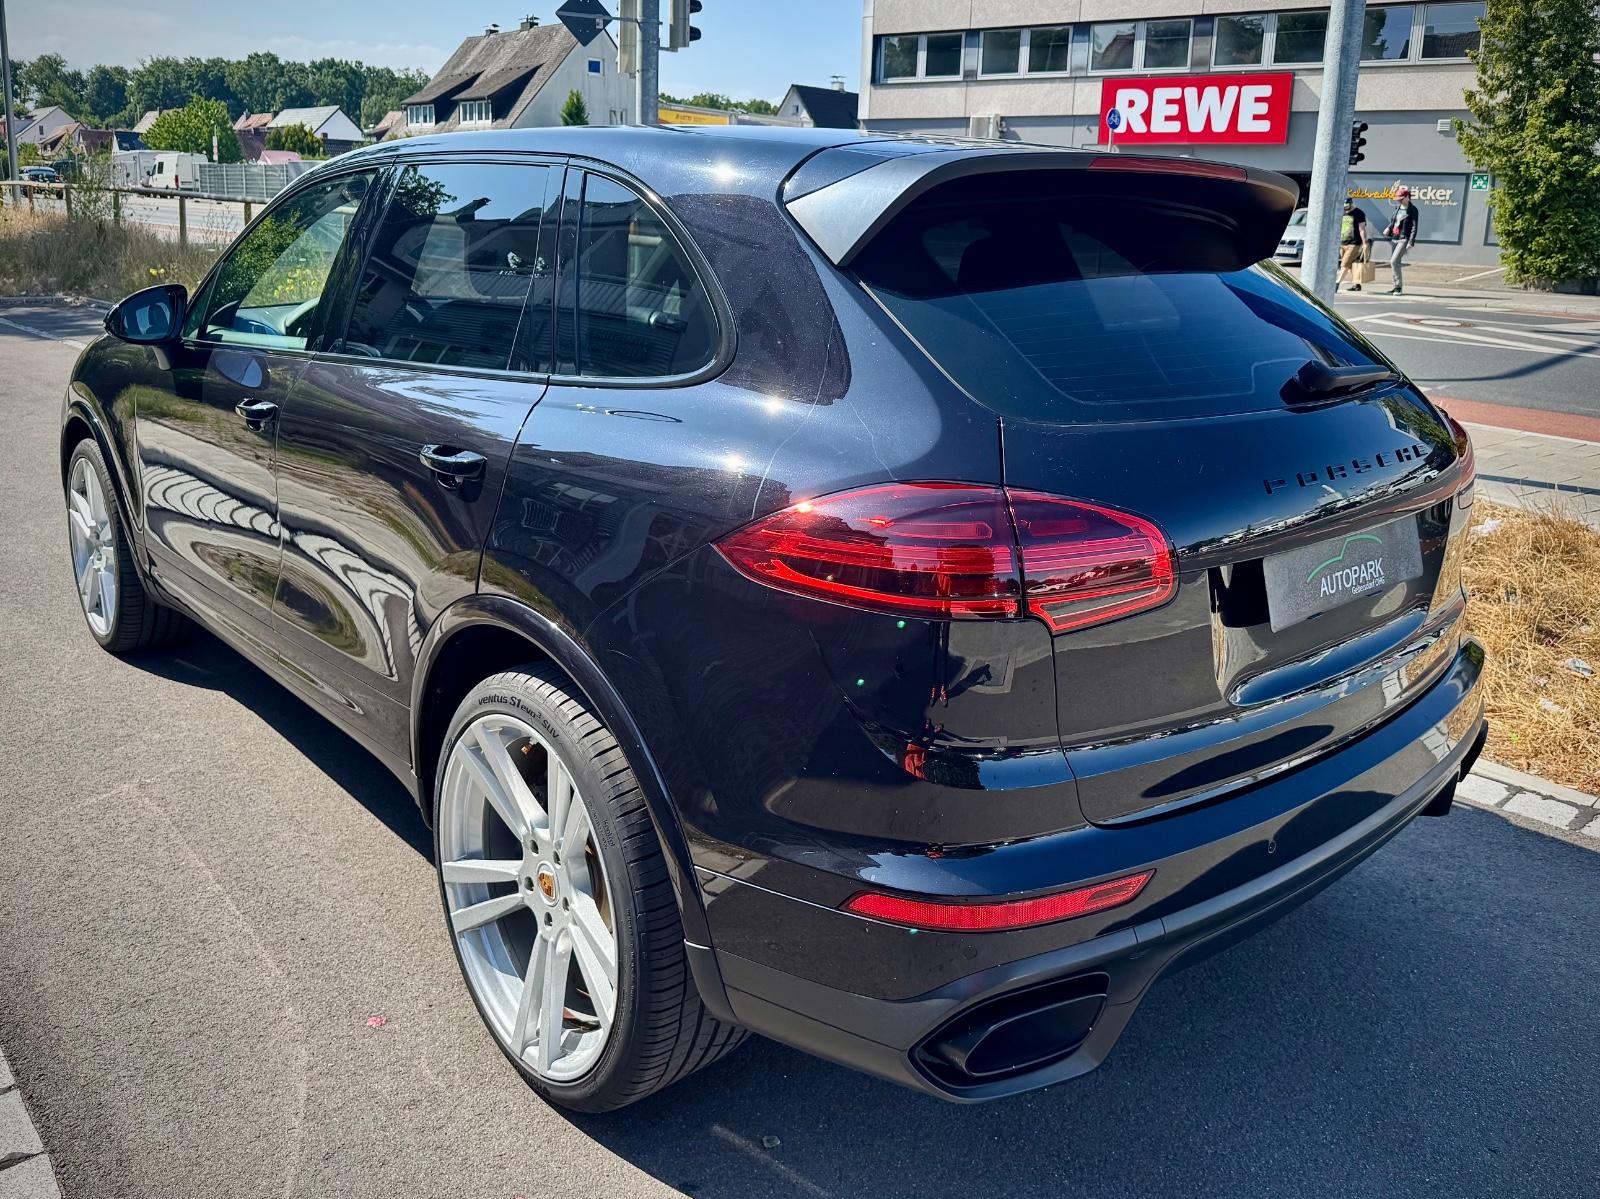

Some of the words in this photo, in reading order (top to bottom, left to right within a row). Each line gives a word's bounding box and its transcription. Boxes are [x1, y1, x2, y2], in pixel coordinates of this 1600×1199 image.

[1113, 85, 1272, 133] REWE
[1263, 443, 1428, 494] PORSCHE
[1320, 557, 1384, 598] AUTOPARK
